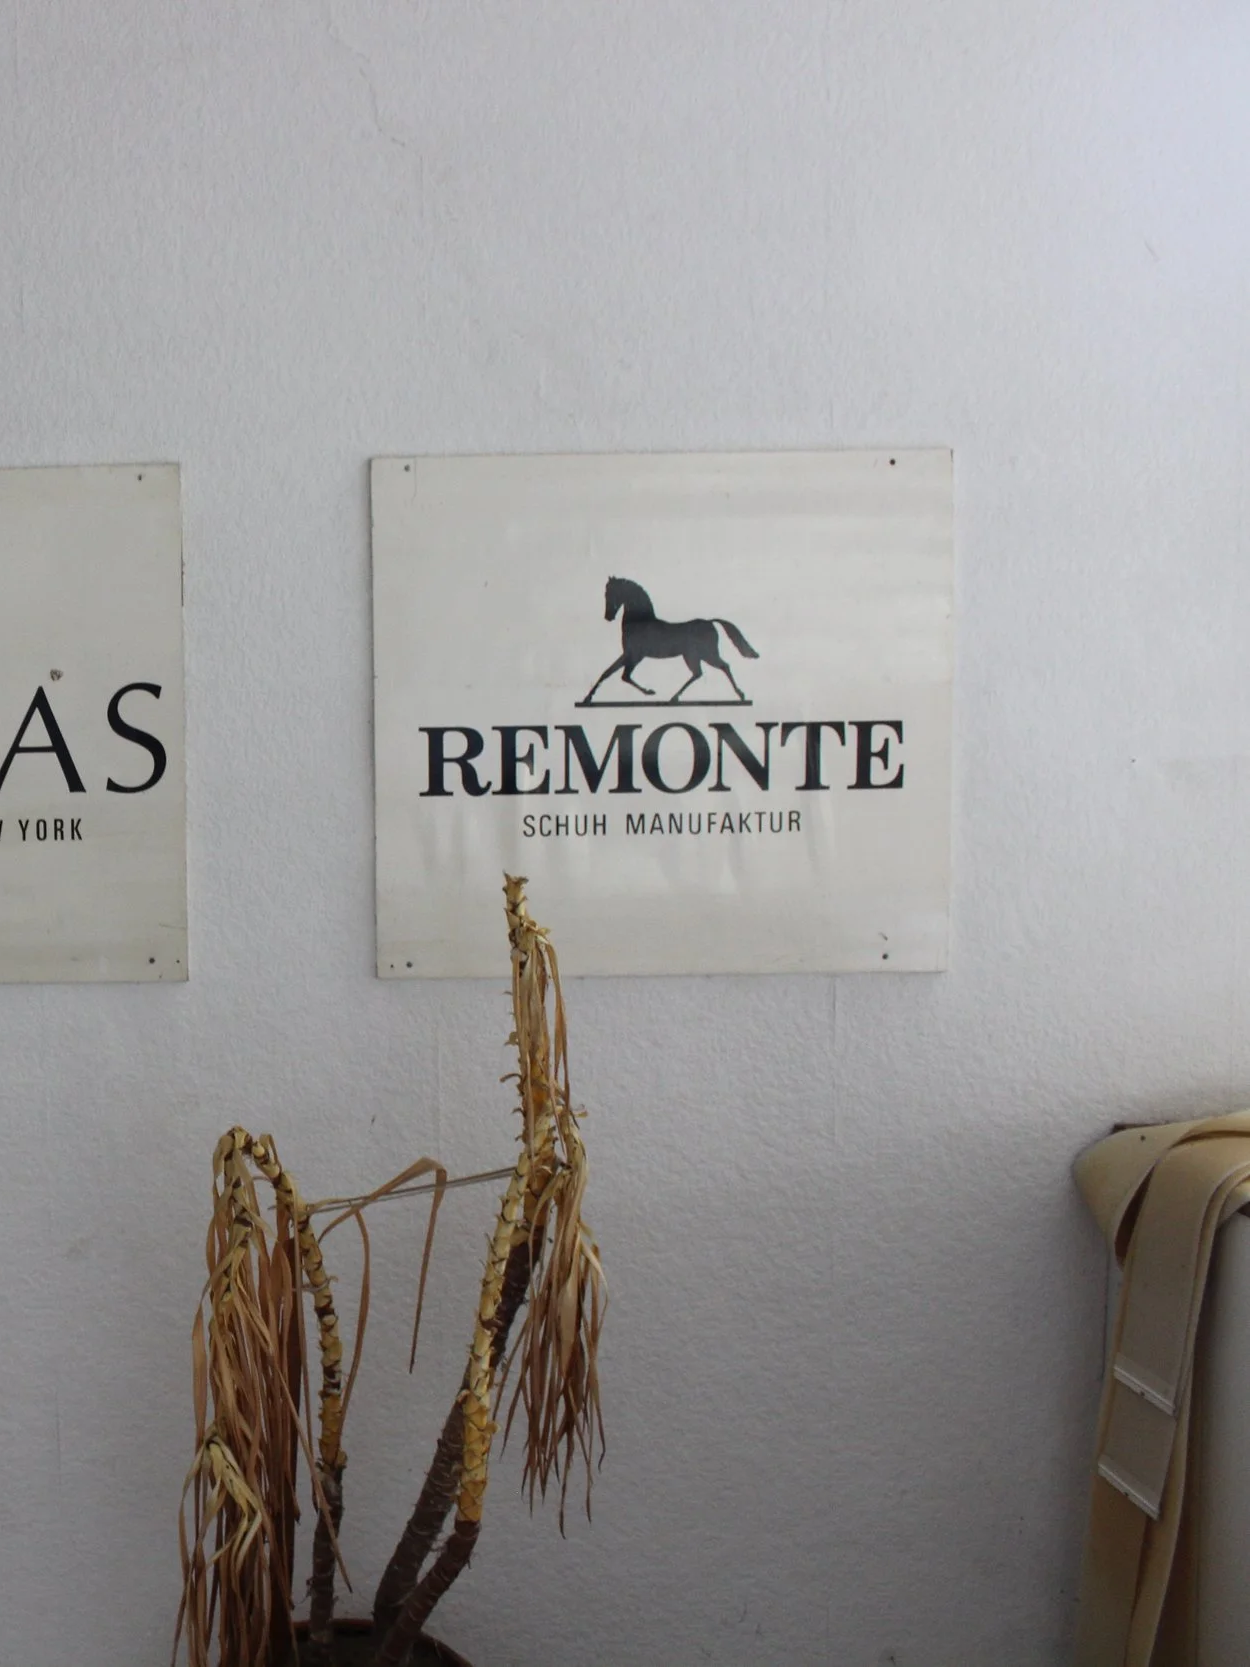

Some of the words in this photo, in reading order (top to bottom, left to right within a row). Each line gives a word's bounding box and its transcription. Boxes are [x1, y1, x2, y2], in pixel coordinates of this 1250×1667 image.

[418, 720, 905, 797] REMONTE
[18, 818, 84, 842] YORK
[522, 814, 608, 838] SCHUH
[626, 810, 802, 836] MANUFAKTUR
